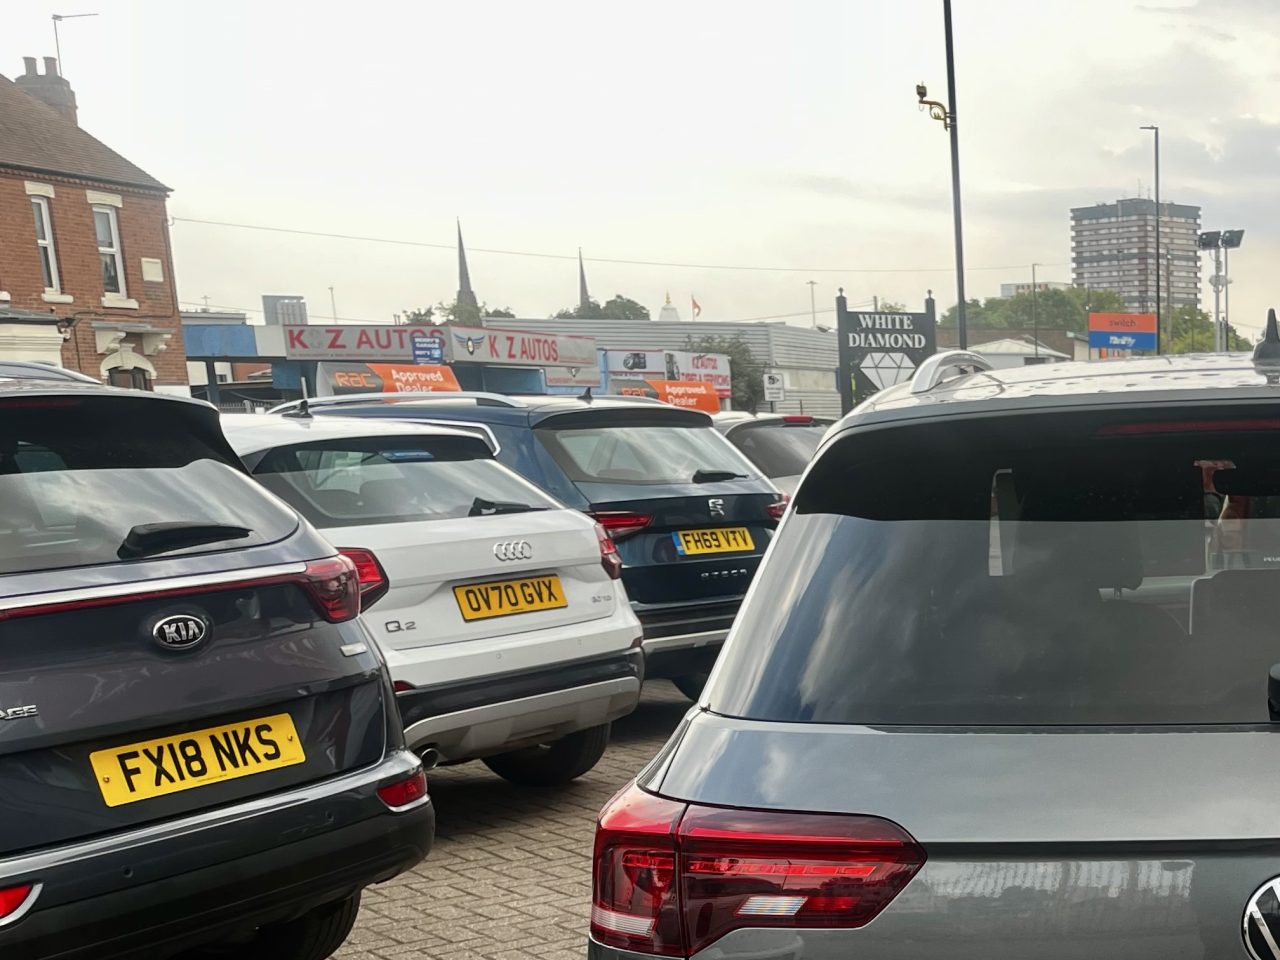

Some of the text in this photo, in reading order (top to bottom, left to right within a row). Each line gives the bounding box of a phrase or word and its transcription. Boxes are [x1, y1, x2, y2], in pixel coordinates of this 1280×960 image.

[858, 314, 914, 330] WHITE
[288, 329, 309, 349] K
[325, 329, 347, 349] Z
[848, 333, 926, 348] DIAMOND
[488, 335, 558, 361] K Z AUTOS
[335, 372, 376, 388] RAC
[391, 369, 444, 383] Approved
[396, 383, 433, 393] Dealer
[665, 385, 707, 395] Approved
[668, 396, 698, 406] Dealer
[682, 531, 722, 551] FH69
[465, 579, 558, 612] OV70 GVX
[163, 620, 201, 643] KIA
[116, 723, 282, 793] FX18 NKS
